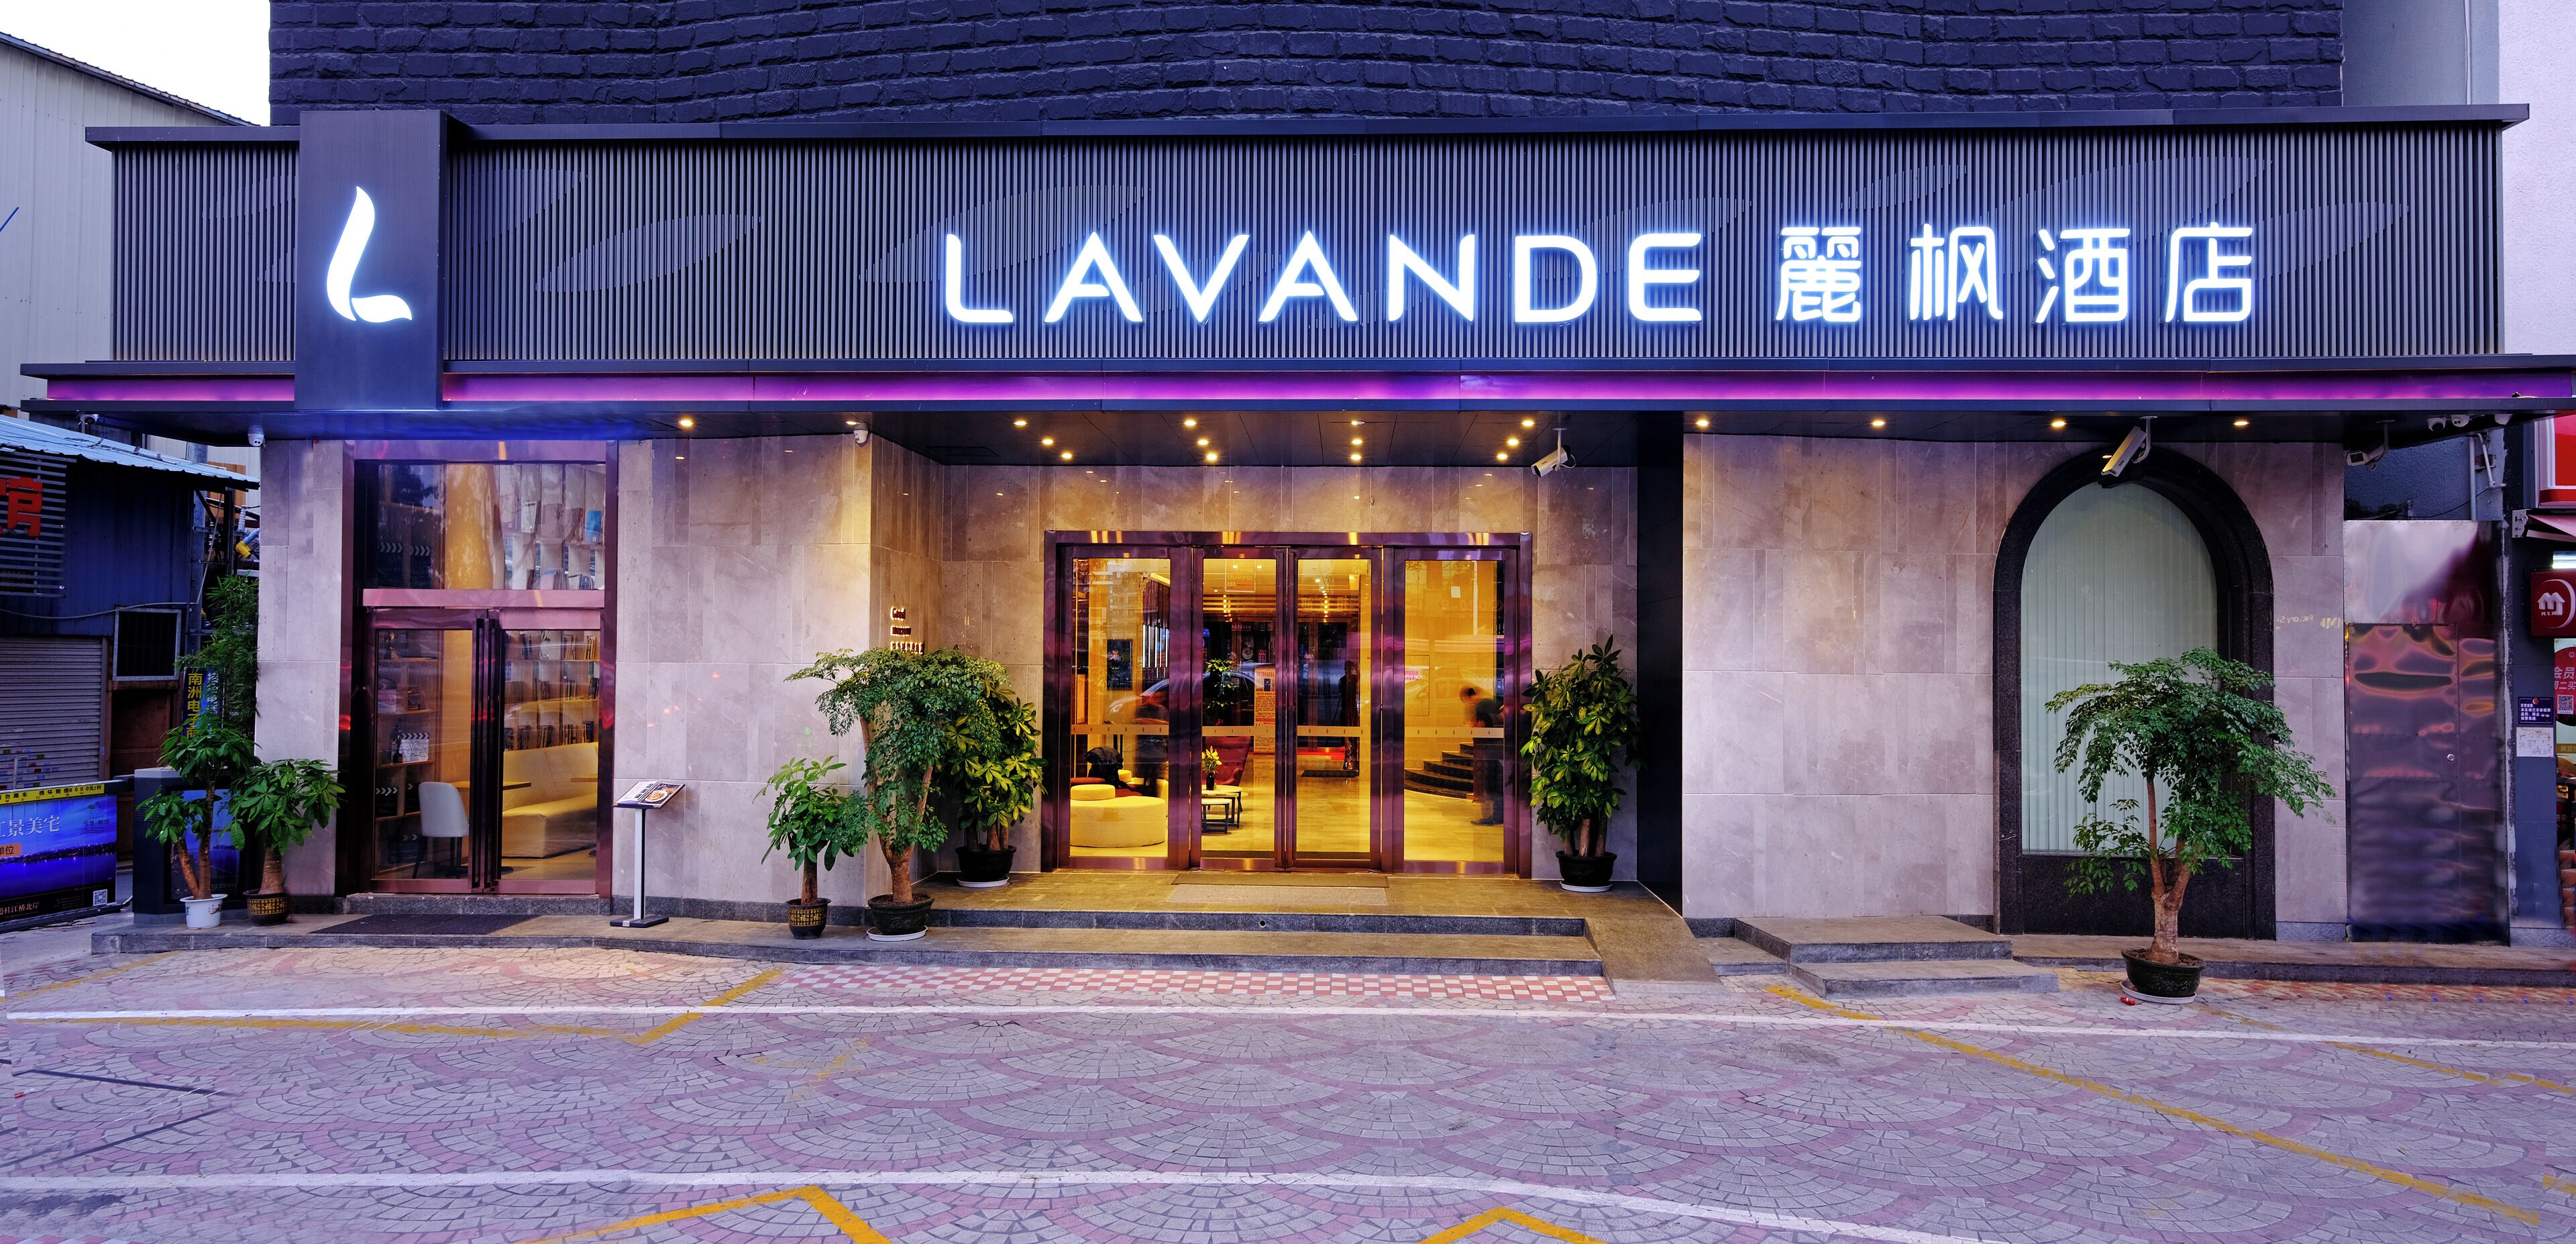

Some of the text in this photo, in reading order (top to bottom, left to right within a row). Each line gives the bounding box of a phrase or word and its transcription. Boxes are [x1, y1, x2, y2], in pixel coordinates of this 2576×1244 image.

[945, 231, 1703, 323] LAVANDE
[1776, 222, 2254, 323] 麗枫酒店
